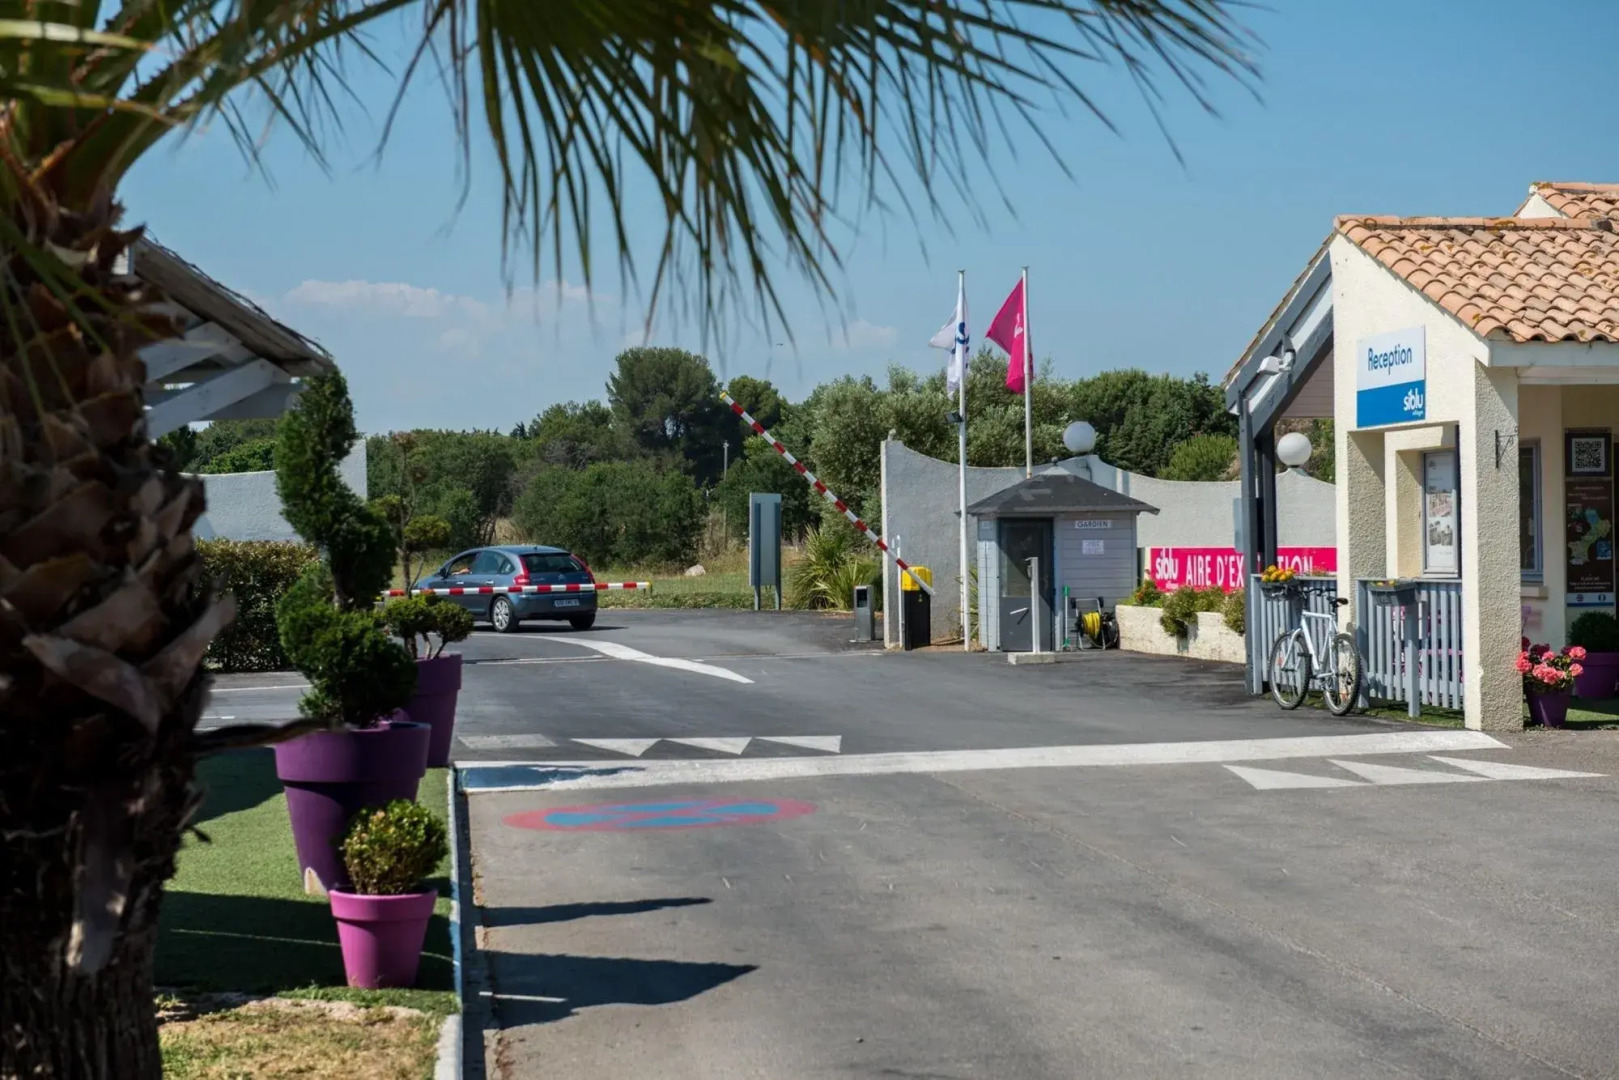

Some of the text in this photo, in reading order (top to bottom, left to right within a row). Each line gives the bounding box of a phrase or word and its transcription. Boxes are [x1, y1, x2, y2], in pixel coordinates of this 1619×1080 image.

[1367, 343, 1413, 375] Reception
[1077, 520, 1108, 528] GARDIEN
[1185, 555, 1212, 587] AIRE
